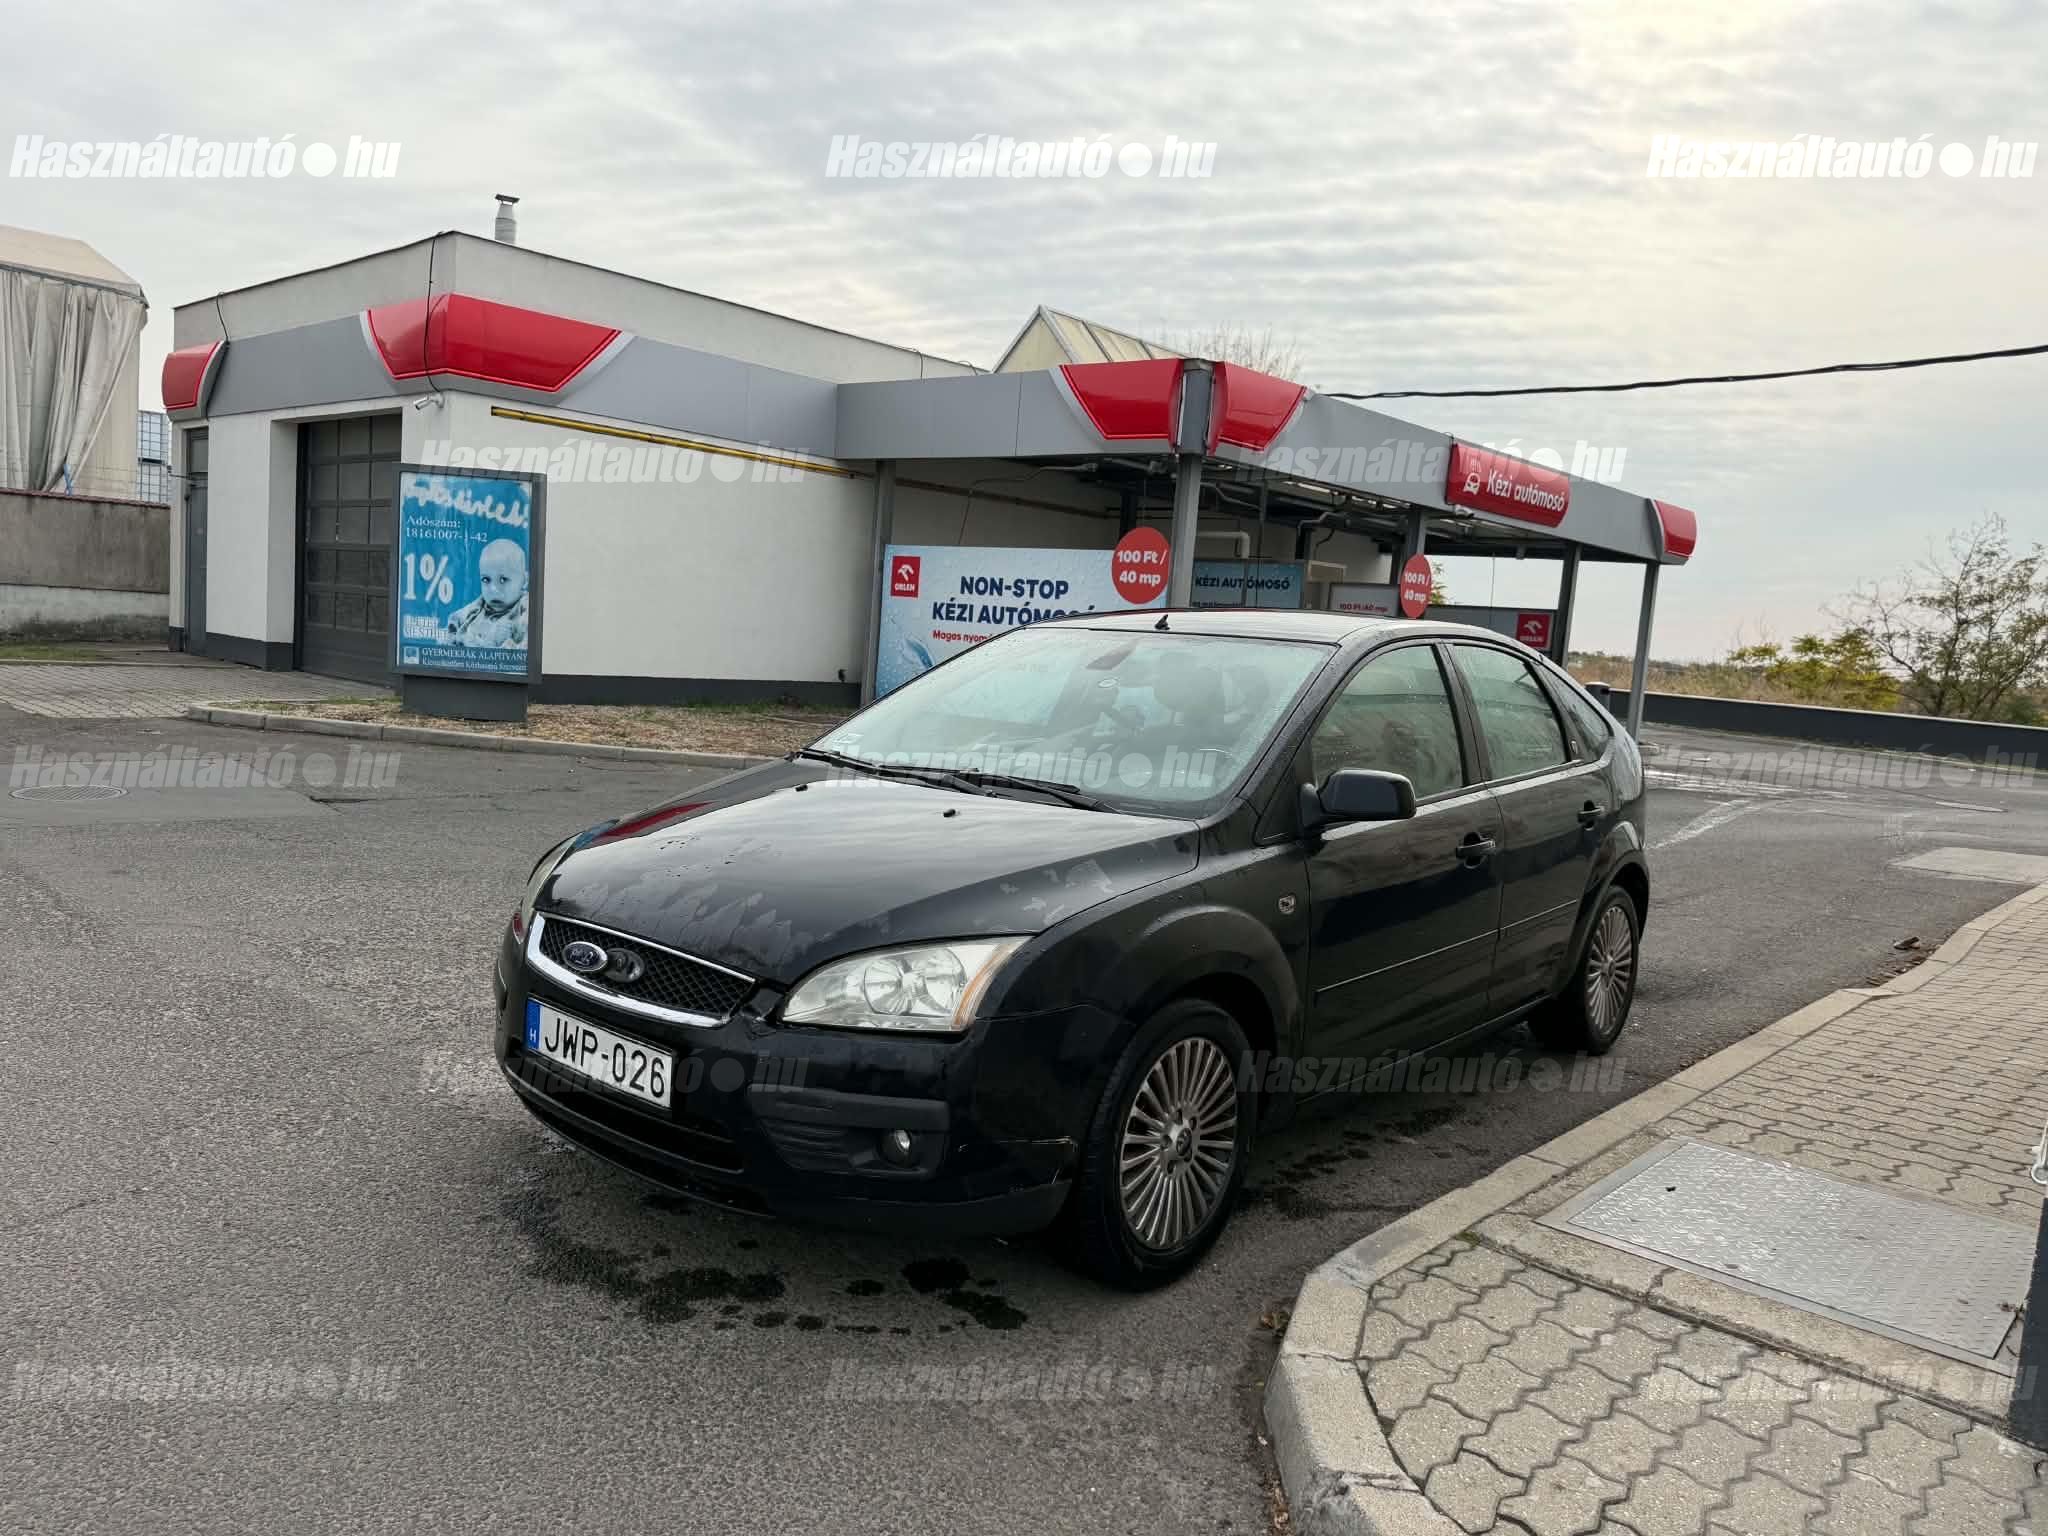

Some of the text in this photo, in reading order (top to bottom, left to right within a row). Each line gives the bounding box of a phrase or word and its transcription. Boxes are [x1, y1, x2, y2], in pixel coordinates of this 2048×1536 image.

[1486, 468, 1565, 512] Kézi autómosó
[1117, 549, 1140, 564] 100
[1143, 550, 1158, 564] Ft
[403, 552, 454, 604] 1%
[1118, 570, 1161, 587] 40 mp
[1195, 574, 1220, 587] KÉZI
[1403, 572, 1417, 584] 100
[894, 583, 916, 592] ORLEN
[959, 575, 1069, 600] NON-STOP
[1403, 590, 1426, 604] 40 mp
[931, 597, 1096, 626] KÉZI AUTÓM
[932, 629, 962, 642] Magas
[528, 1031, 538, 1042] H
[543, 1017, 666, 1099] JWP-026
